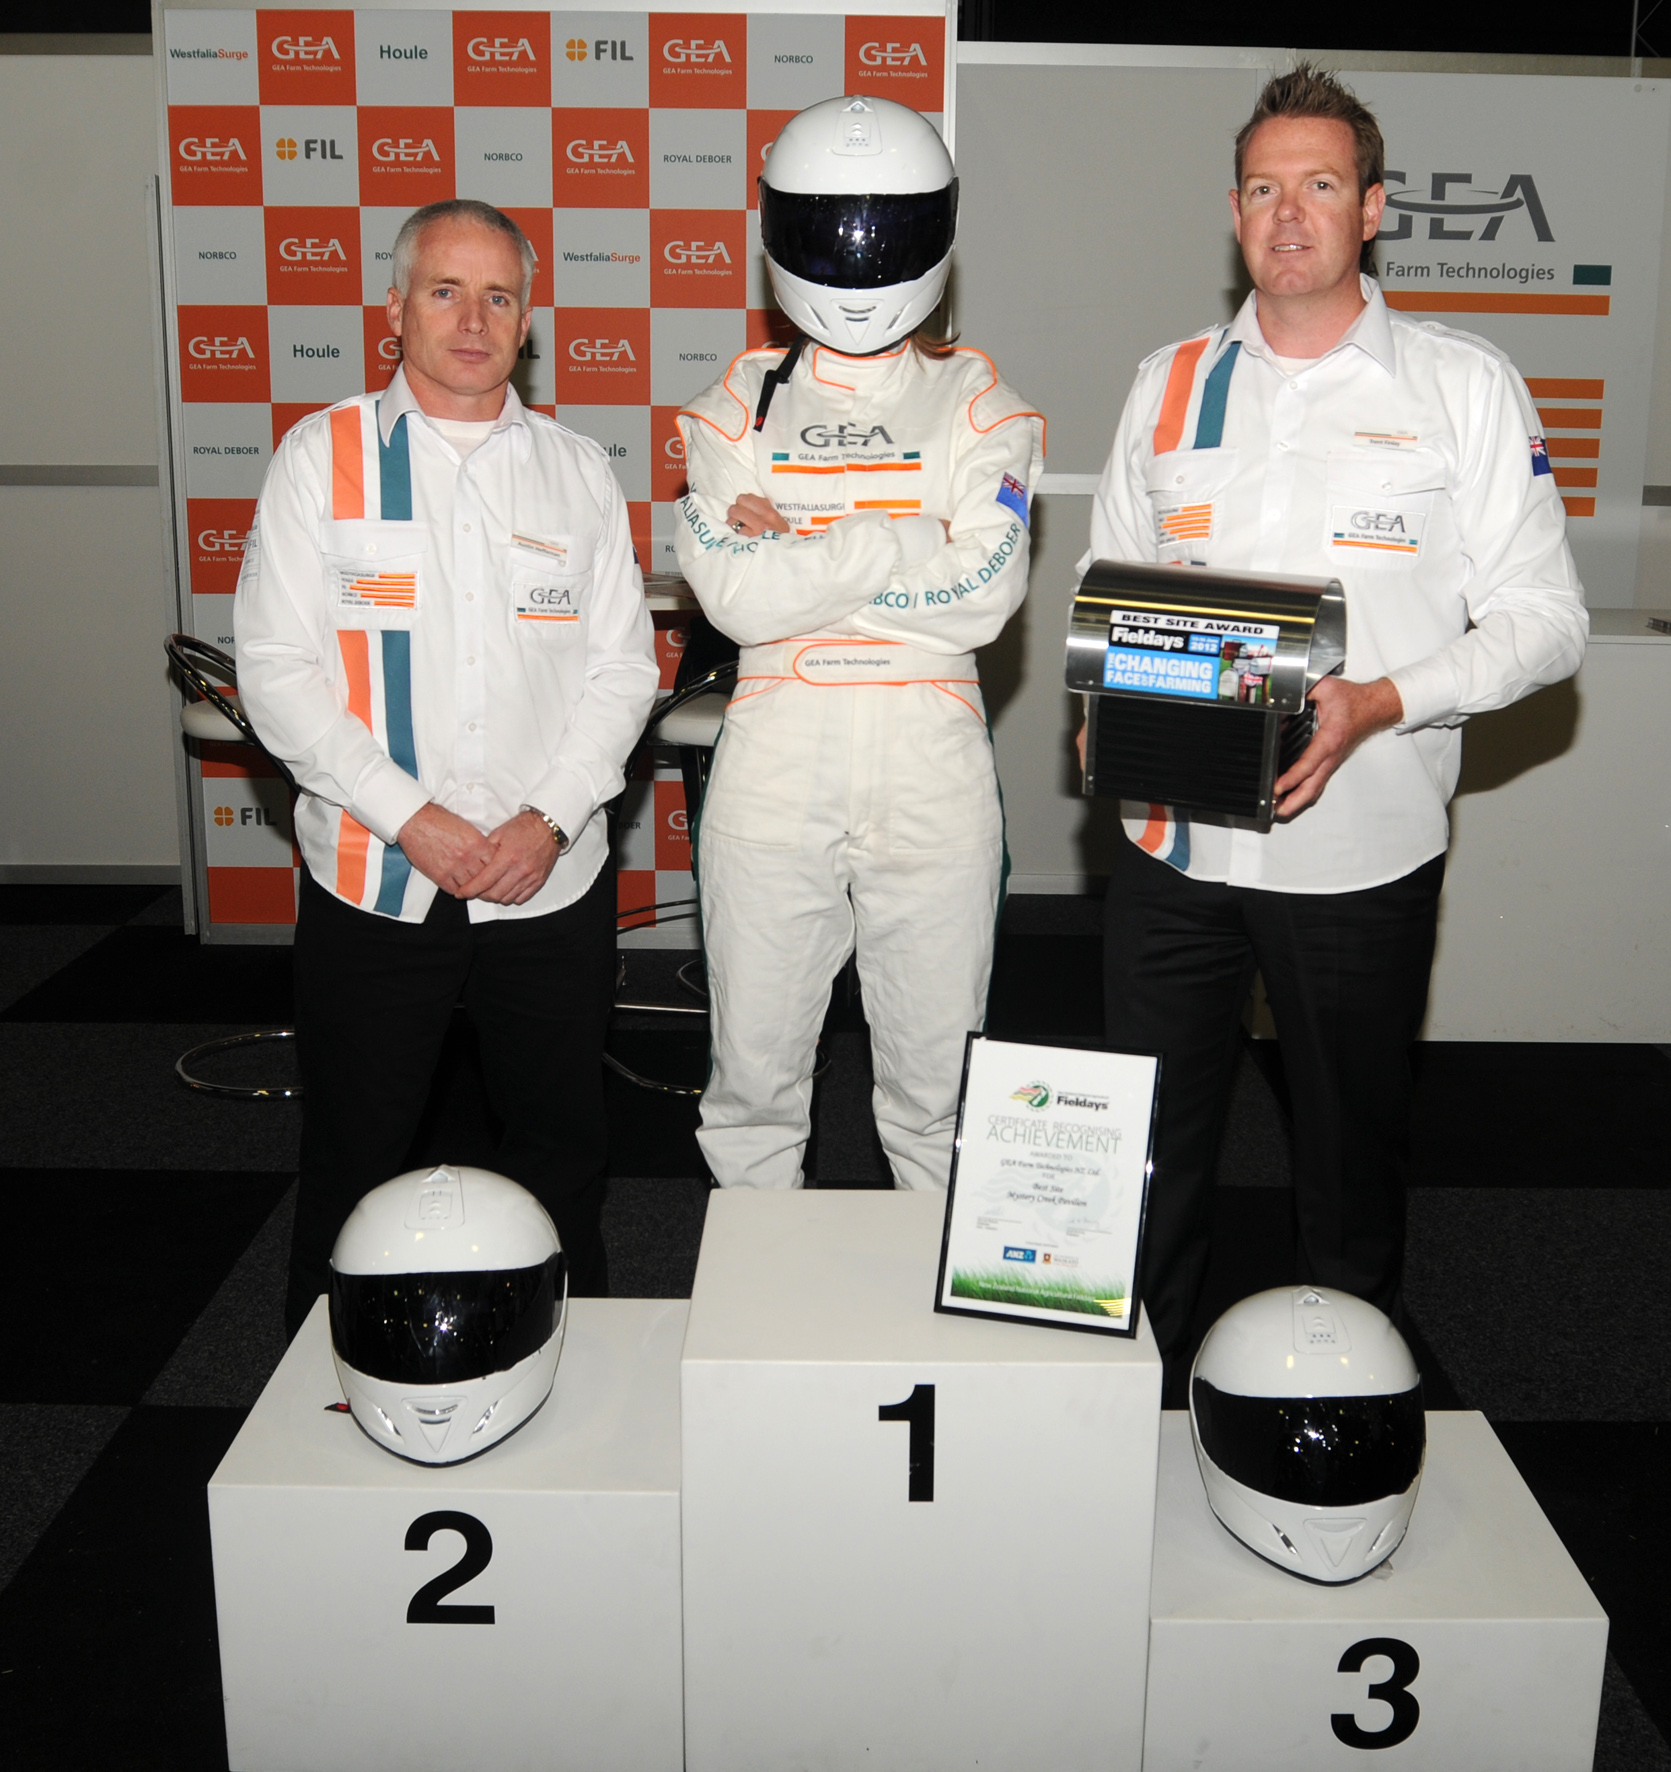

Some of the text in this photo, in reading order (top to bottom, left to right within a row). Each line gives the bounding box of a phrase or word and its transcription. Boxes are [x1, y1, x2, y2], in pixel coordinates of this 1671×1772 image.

[169, 48, 248, 60] WestfaliaSurge
[271, 36, 341, 60] GEA
[379, 45, 428, 60] Houle
[467, 37, 536, 61] GEA
[595, 40, 634, 62] FIL
[663, 39, 731, 63] GEA
[774, 55, 813, 64] NORBCO
[859, 42, 928, 66] GEA
[889, 70, 928, 78] Technologies
[179, 137, 247, 161] GEA
[304, 139, 343, 160] FIL
[372, 138, 441, 161] GEA
[484, 152, 523, 162] NORBCO
[566, 139, 635, 163] GEA
[663, 154, 732, 164] ROYAL DEBOER
[1376, 170, 1556, 242] GEA
[198, 251, 237, 261] NORBCO
[279, 238, 347, 261] GEA
[563, 251, 641, 264] WestfaliaSurge
[664, 240, 731, 264] GEA
[1386, 261, 1430, 278] Farm
[1437, 262, 1555, 284] Technologies
[188, 336, 255, 359] GEA
[293, 344, 340, 359] Houle
[569, 338, 636, 361] GEA
[679, 354, 717, 362] NORBCO
[800, 422, 895, 447] GEA
[193, 446, 260, 456] ROYAL DEBOER
[798, 451, 895, 461] GEA Farm Technologies
[1350, 511, 1407, 533] GEA
[925, 577, 979, 606] ROYAL
[978, 522, 1021, 583] DEBOER
[530, 588, 571, 605] GEA
[1122, 614, 1264, 635] BEST SITE AWARD
[1111, 626, 1185, 651] Fieldays
[1190, 642, 1218, 652] 2012
[805, 658, 891, 668] GEA Farm Technologies
[1114, 653, 1213, 680] CHANGING
[1106, 670, 1141, 686] FACE
[1149, 674, 1212, 694] FARMING
[240, 808, 277, 827] FIL
[1057, 1095, 1108, 1112] Fieldays
[988, 1114, 1122, 1138] CERTIFICATE RECOGNISING
[986, 1125, 1122, 1154] ACHIEVEMENT
[878, 1384, 936, 1502] 1
[404, 1510, 496, 1625] 2
[1330, 1637, 1421, 1750] 3
